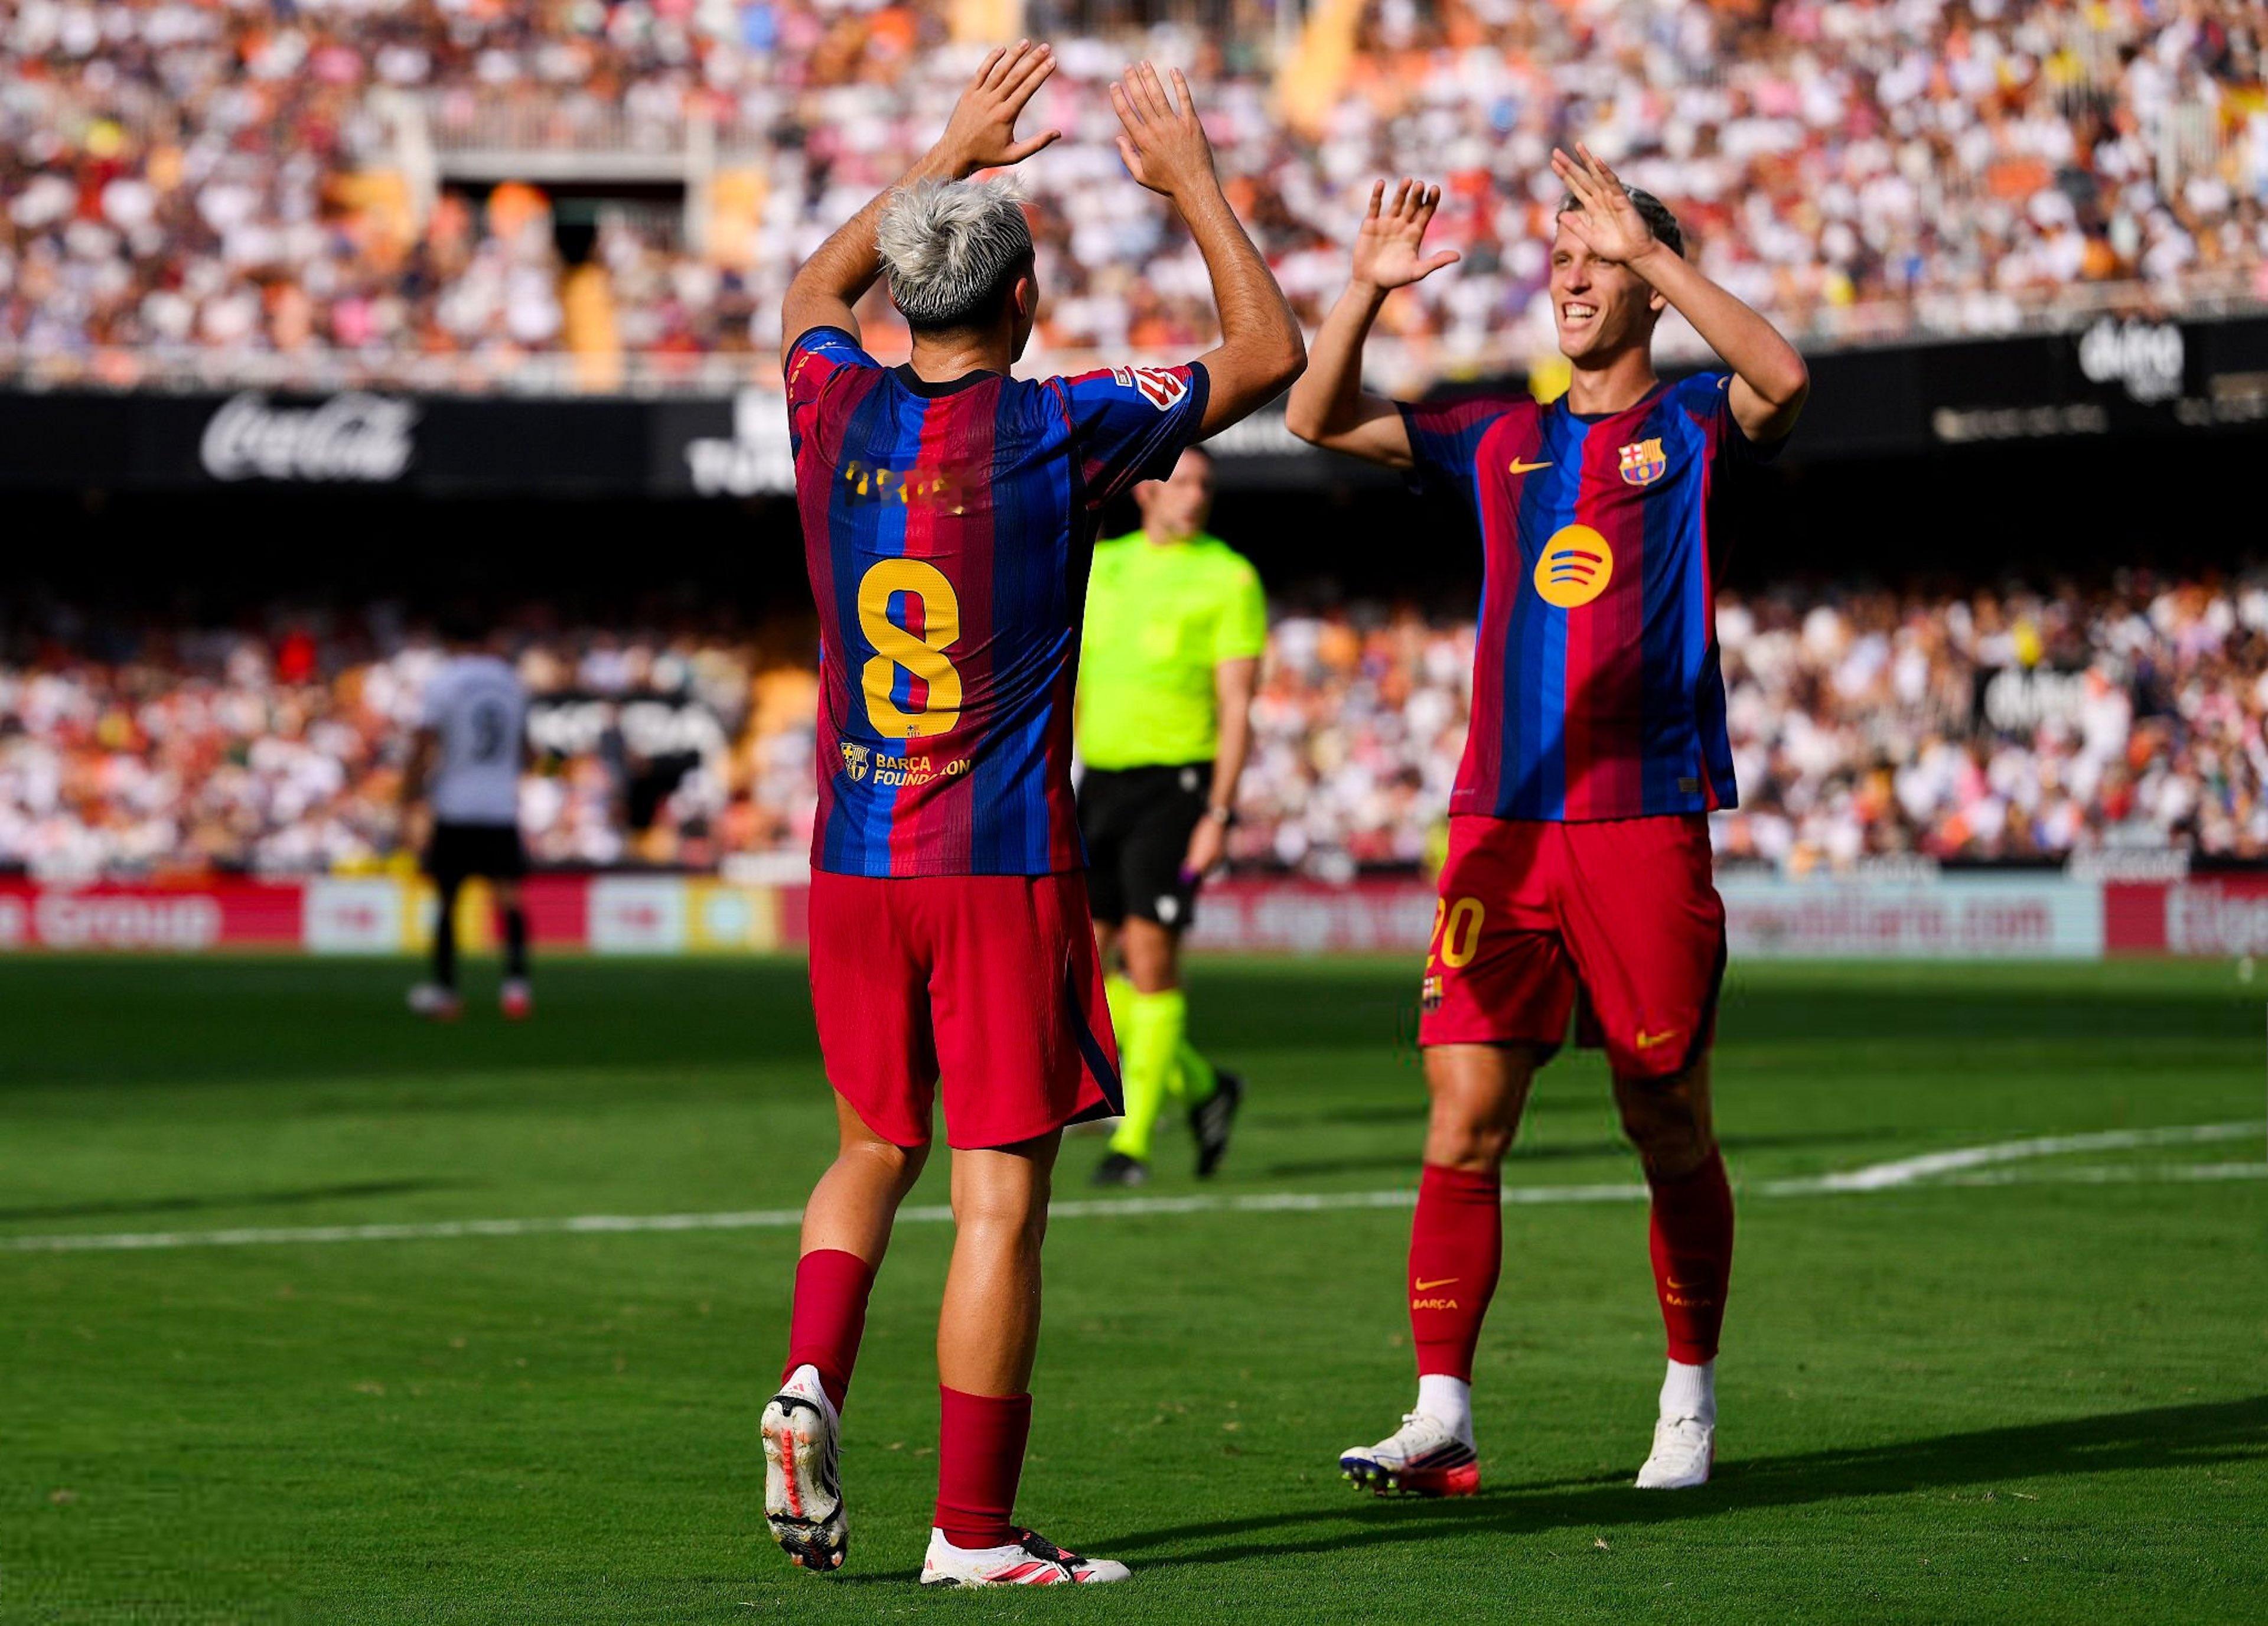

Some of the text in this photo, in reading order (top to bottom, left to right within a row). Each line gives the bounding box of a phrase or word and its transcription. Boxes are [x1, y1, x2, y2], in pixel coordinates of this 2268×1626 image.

[858, 558, 963, 738] 8
[873, 759, 971, 786] FOUNDON
[876, 752, 931, 774] BARÇA
[1412, 1298, 1458, 1311] BARÇA
